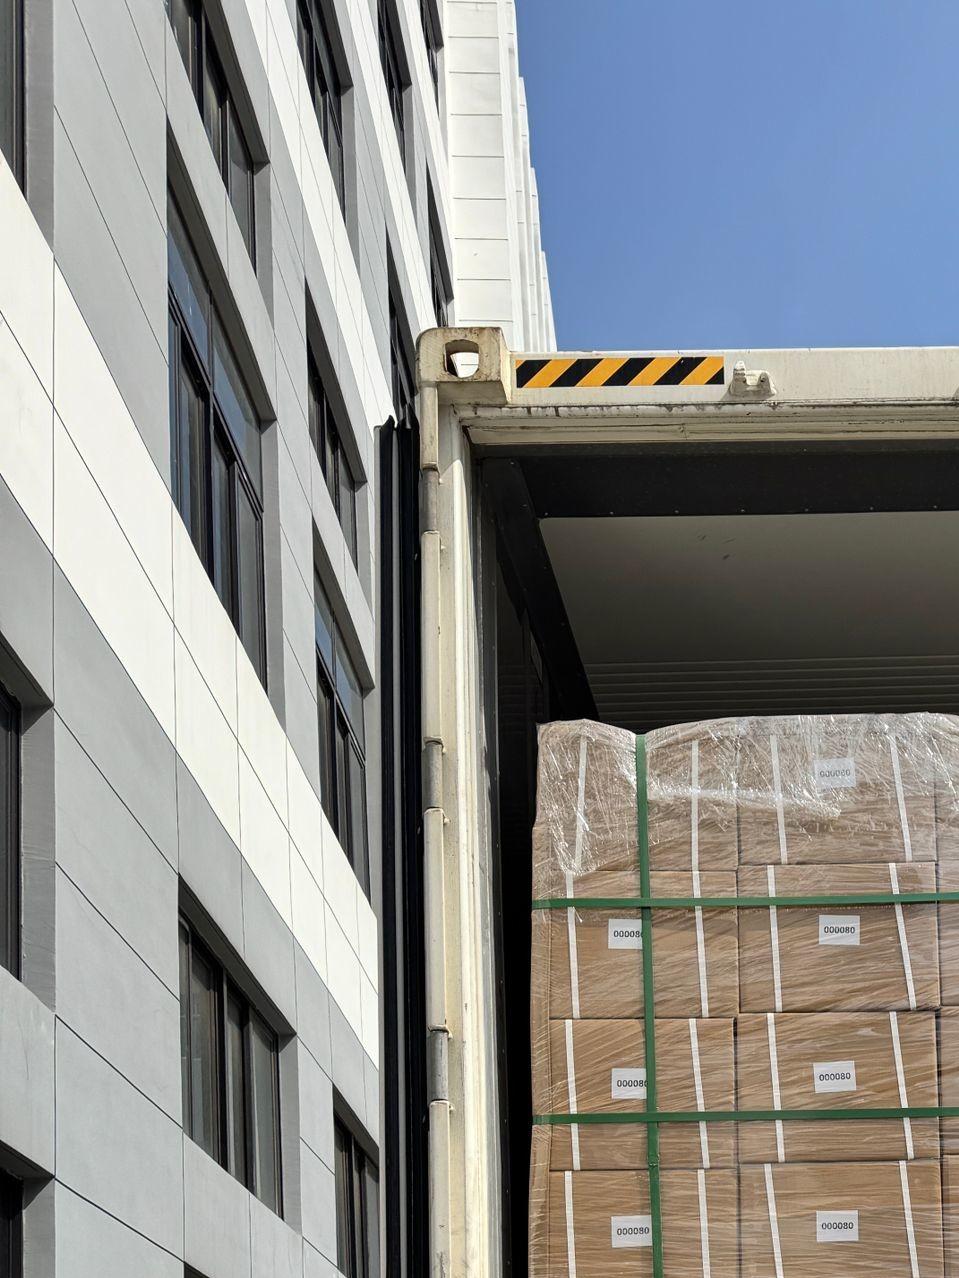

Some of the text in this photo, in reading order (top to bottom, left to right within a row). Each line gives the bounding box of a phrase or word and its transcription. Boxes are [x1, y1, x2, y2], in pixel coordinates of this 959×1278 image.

[823, 925, 856, 935] 000080
[818, 1071, 852, 1082] 000080
[821, 1220, 854, 1231] 000080
[616, 1226, 650, 1236] 000080
